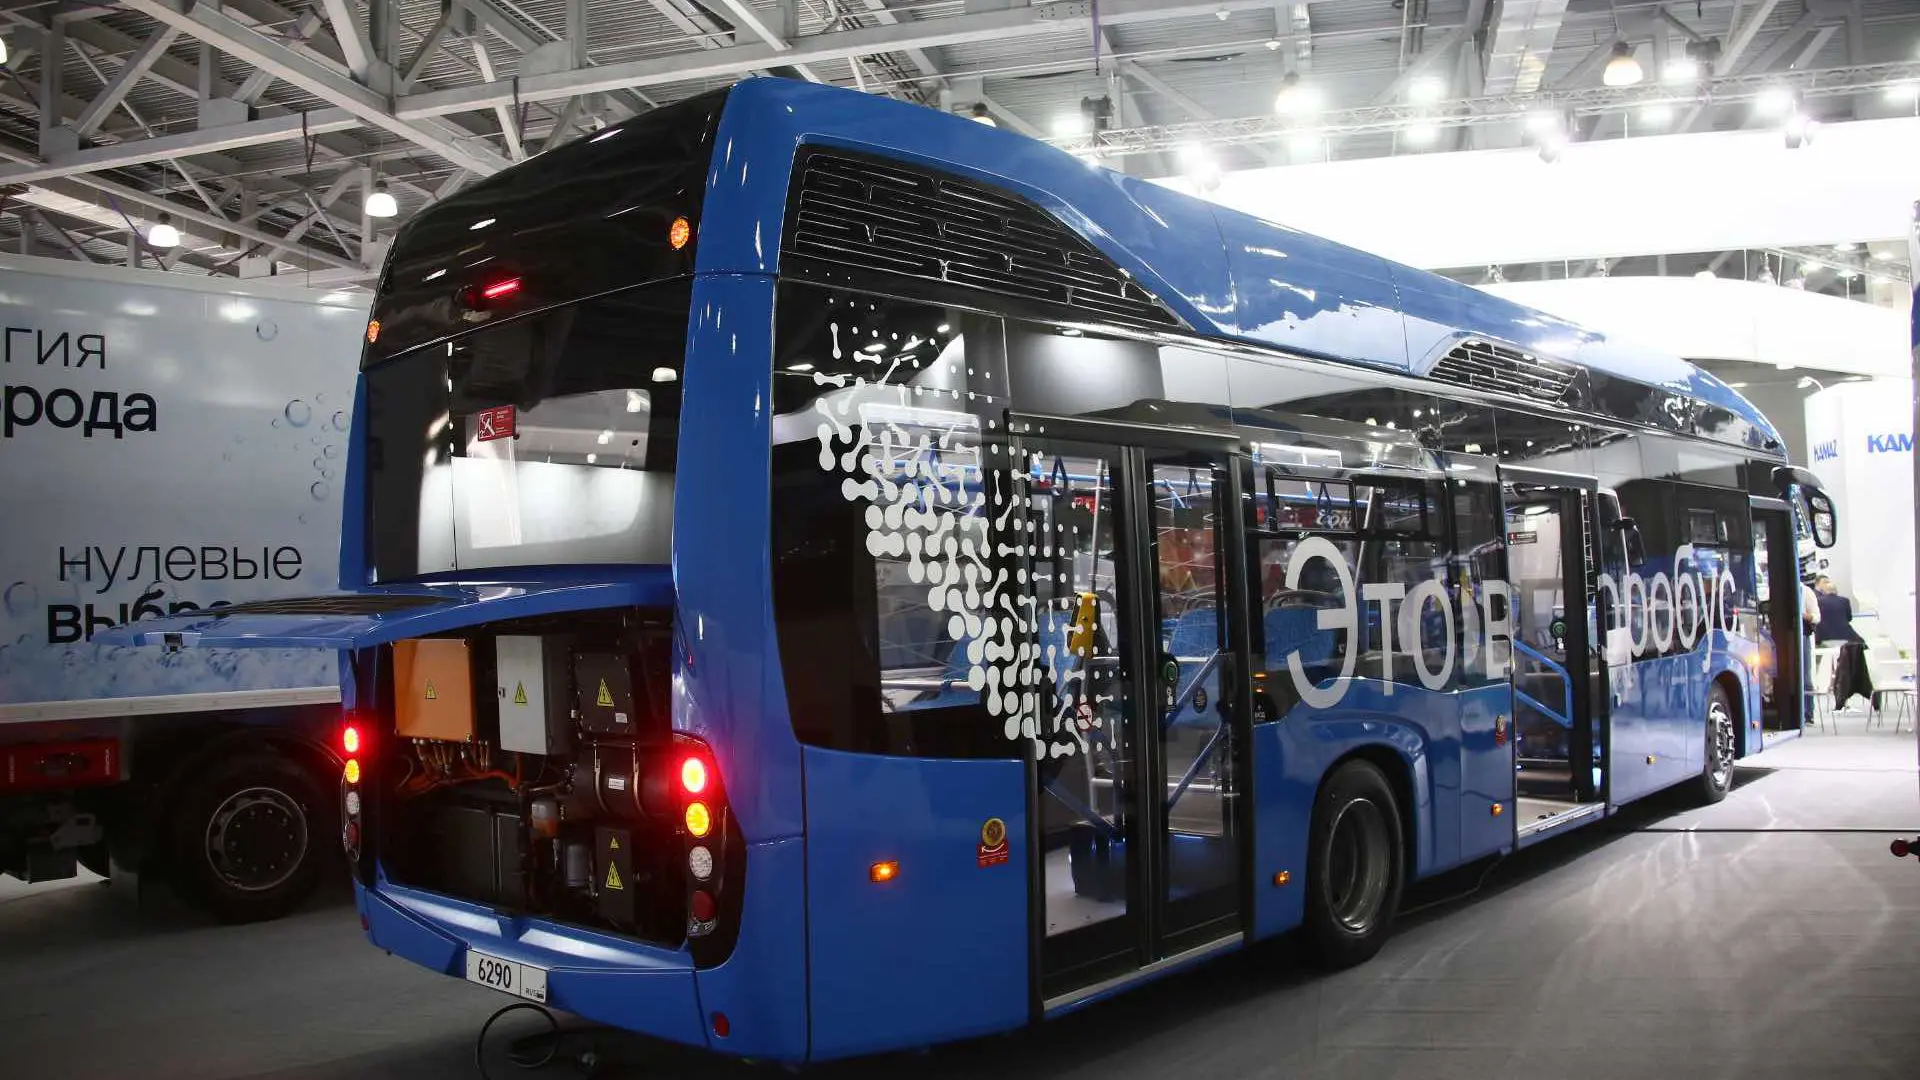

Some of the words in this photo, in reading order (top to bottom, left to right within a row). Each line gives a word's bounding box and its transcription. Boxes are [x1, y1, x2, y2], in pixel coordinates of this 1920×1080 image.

[0, 385, 157, 439] рода
[1813, 439, 1838, 463] KAMAZ
[59, 545, 303, 594] нулевые
[478, 958, 512, 989] 6290
